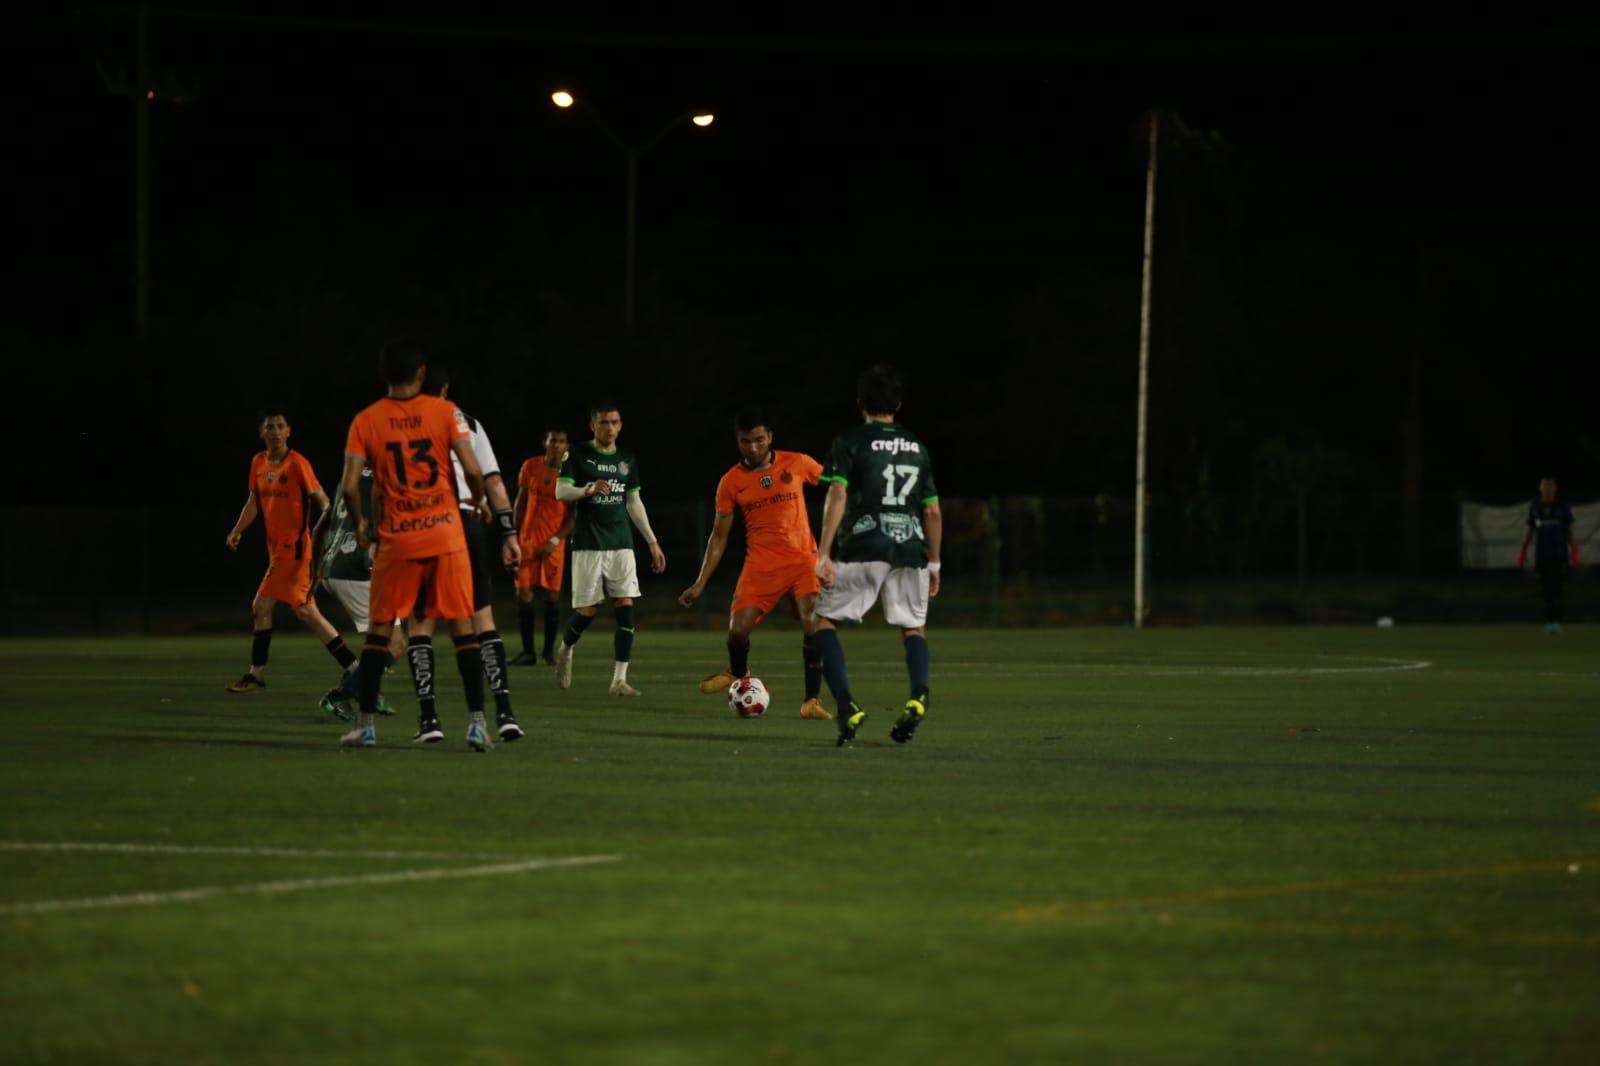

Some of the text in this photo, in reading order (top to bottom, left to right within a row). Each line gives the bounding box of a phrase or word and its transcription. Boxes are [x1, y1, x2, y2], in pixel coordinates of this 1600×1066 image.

[385, 438, 439, 490] 13
[871, 438, 920, 455] crefisa
[881, 464, 919, 505] 17
